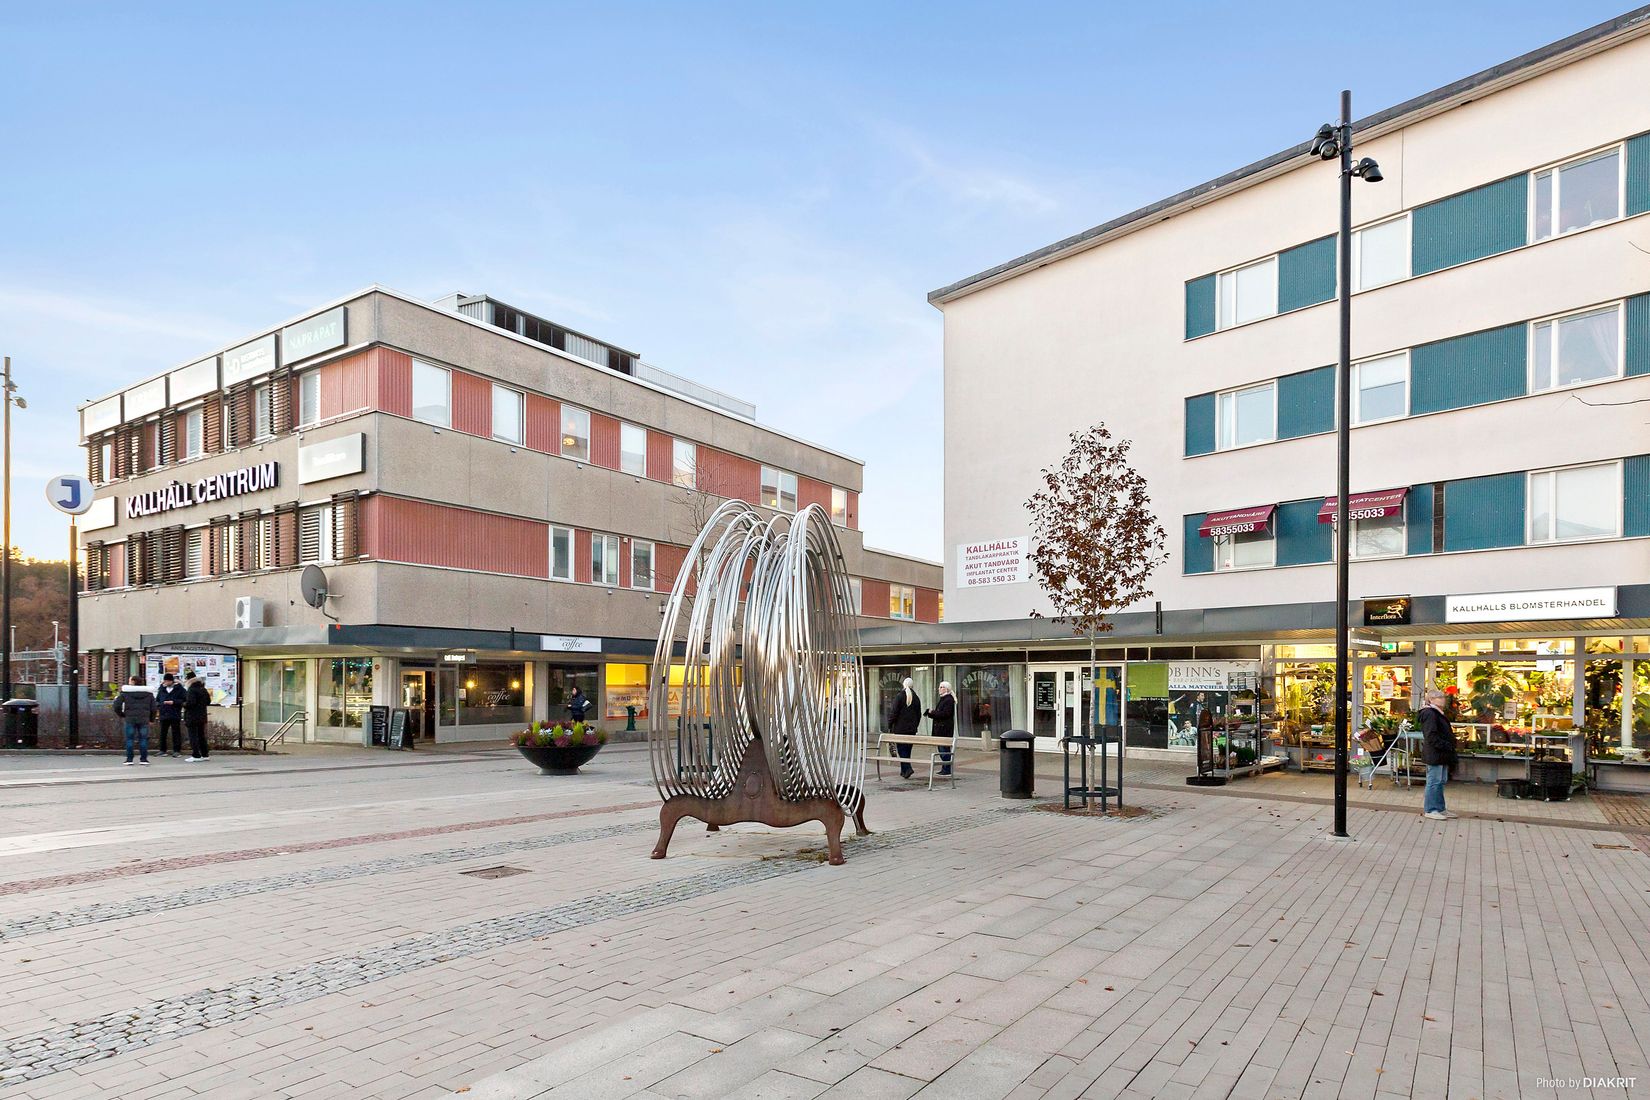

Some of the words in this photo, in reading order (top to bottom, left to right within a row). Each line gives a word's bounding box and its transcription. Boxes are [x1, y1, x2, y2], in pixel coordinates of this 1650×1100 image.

[57, 478, 81, 509] J
[125, 480, 194, 519] KALLHÄLL
[195, 461, 279, 504] CENTRUM
[1325, 493, 1402, 507] IMPNTATCENTER
[1331, 508, 1385, 522] 555033
[1210, 523, 1255, 536] 58355033
[966, 540, 1018, 555] KALLHÄLLS
[966, 569, 996, 577] IMPLANTAT
[968, 577, 991, 585] 08-583
[992, 575, 1006, 583] 550
[1509, 599, 1606, 610] BLOMSTERHANDEL
[1186, 666, 1221, 678] INN's
[486, 688, 511, 703] coffee
